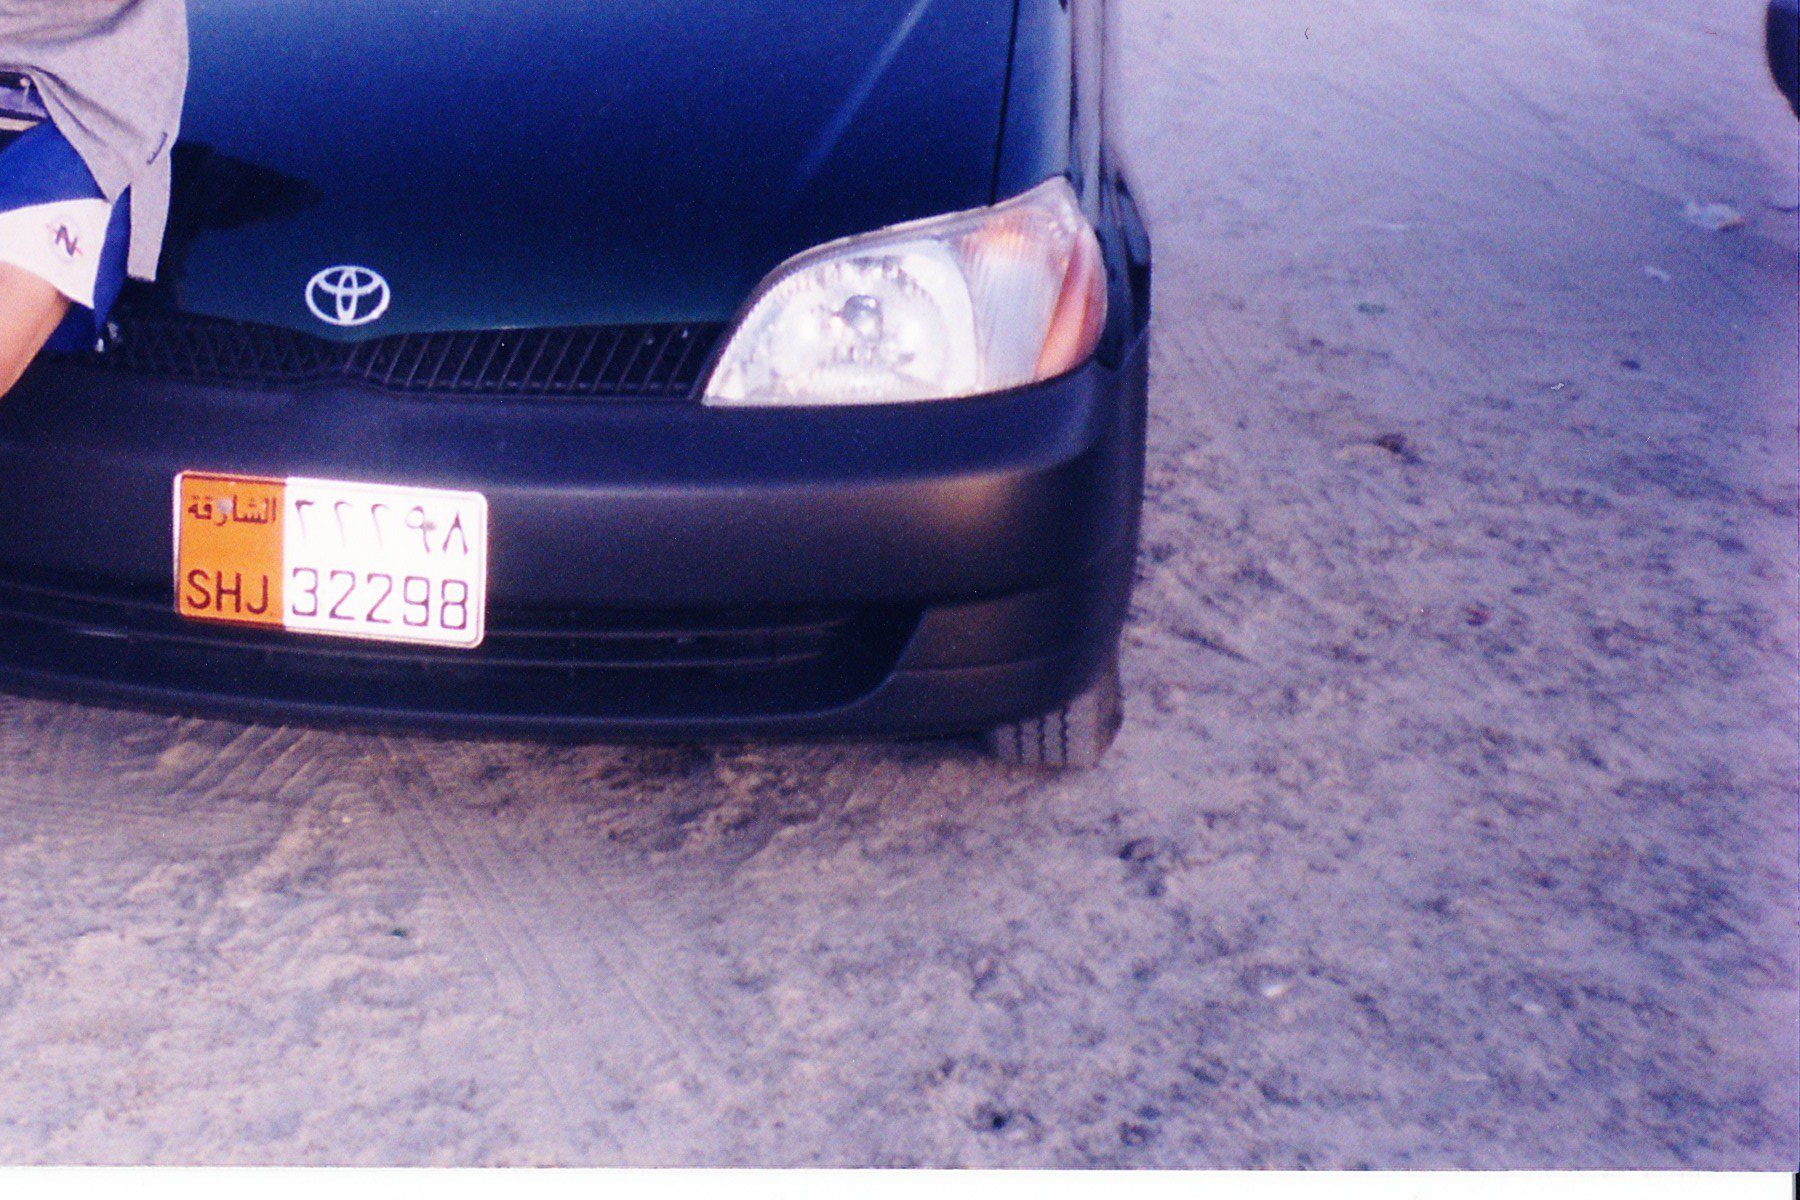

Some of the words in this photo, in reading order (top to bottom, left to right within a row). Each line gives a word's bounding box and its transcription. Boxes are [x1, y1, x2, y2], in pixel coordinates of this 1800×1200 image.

[187, 494, 278, 527] الشارقة
[186, 568, 270, 616] SHJ
[291, 566, 470, 631] 32298
